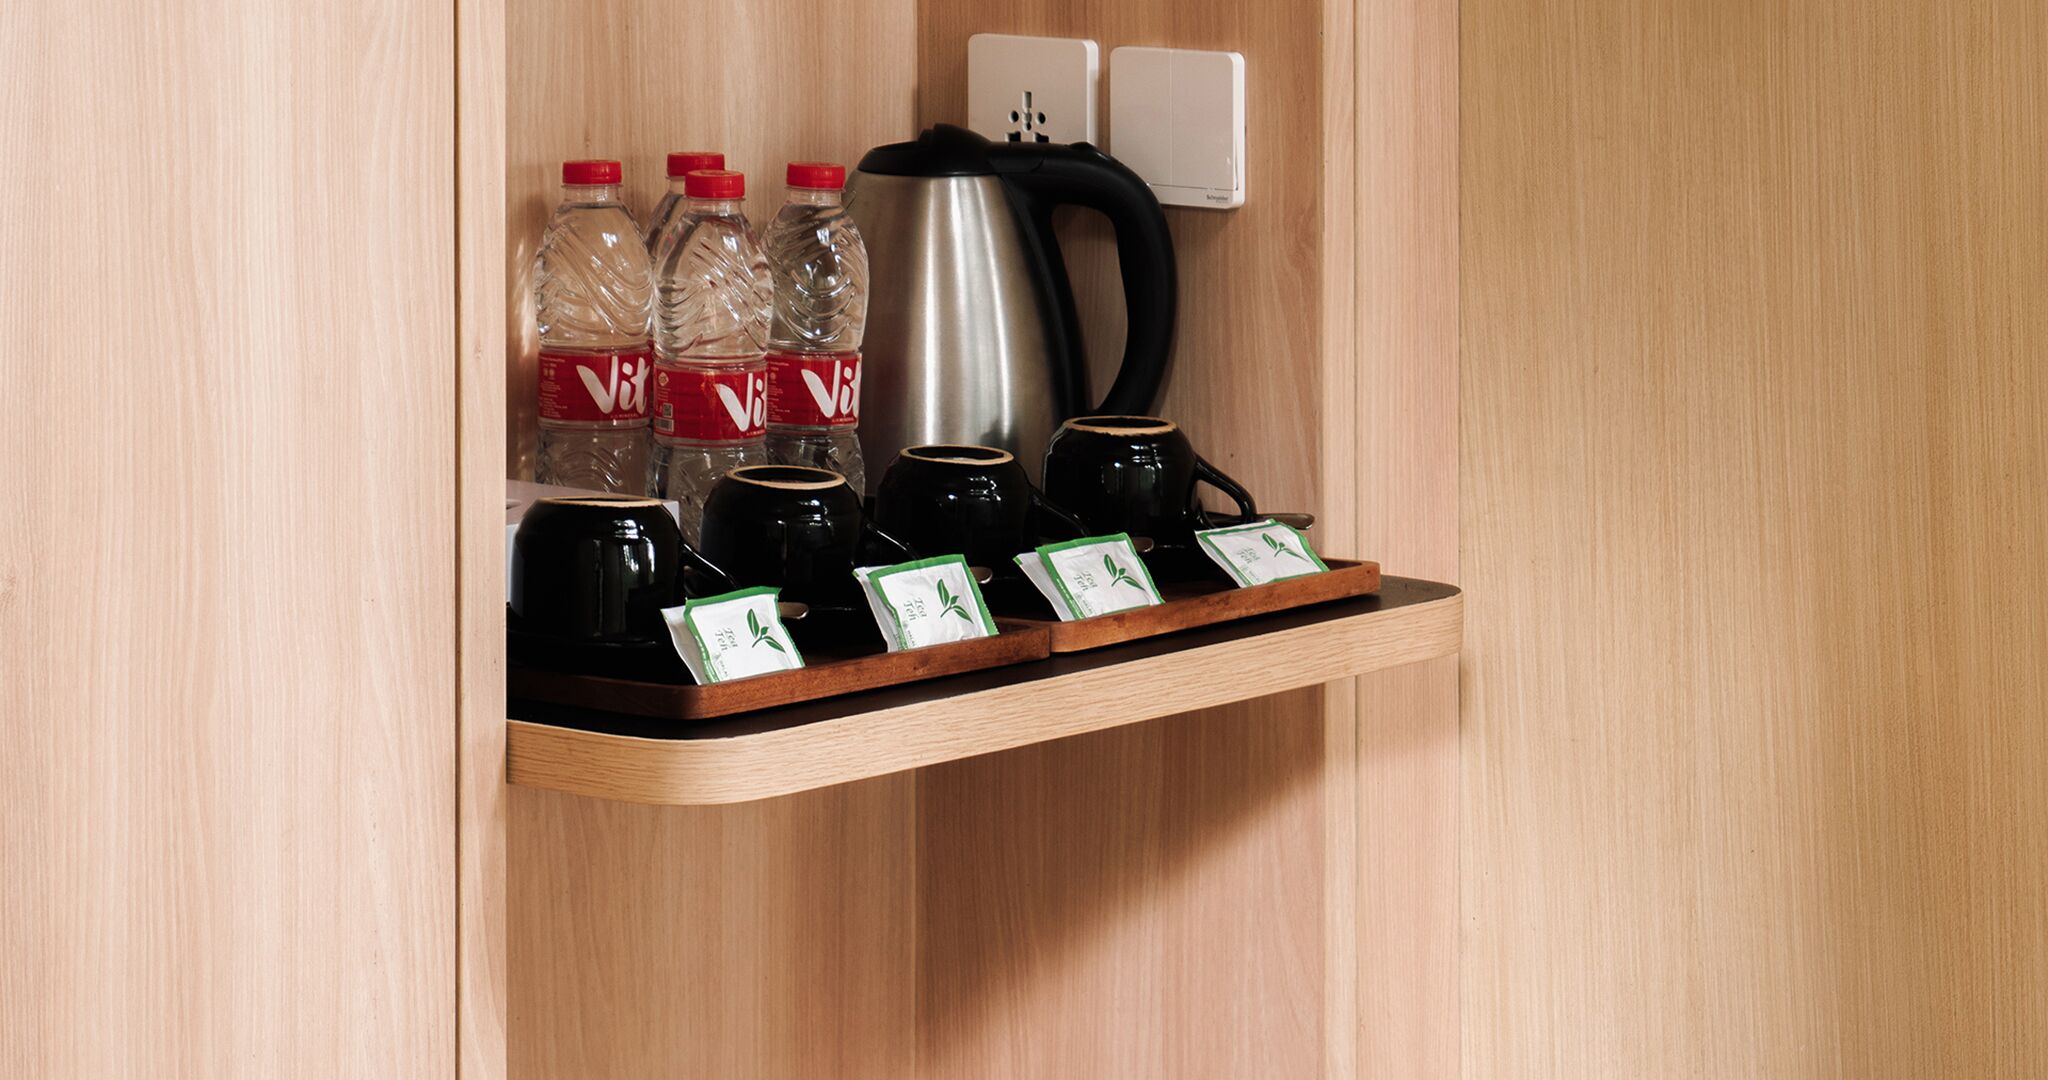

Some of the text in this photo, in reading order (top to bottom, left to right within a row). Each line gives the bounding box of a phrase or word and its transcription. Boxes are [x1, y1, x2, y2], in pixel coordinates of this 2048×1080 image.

[576, 355, 650, 414] Vit
[1073, 574, 1089, 591] Teh
[1082, 571, 1098, 589] Tea
[904, 600, 917, 621] Teh
[914, 597, 927, 618] Tea
[715, 630, 728, 651] Teh
[724, 627, 738, 648] Tea
